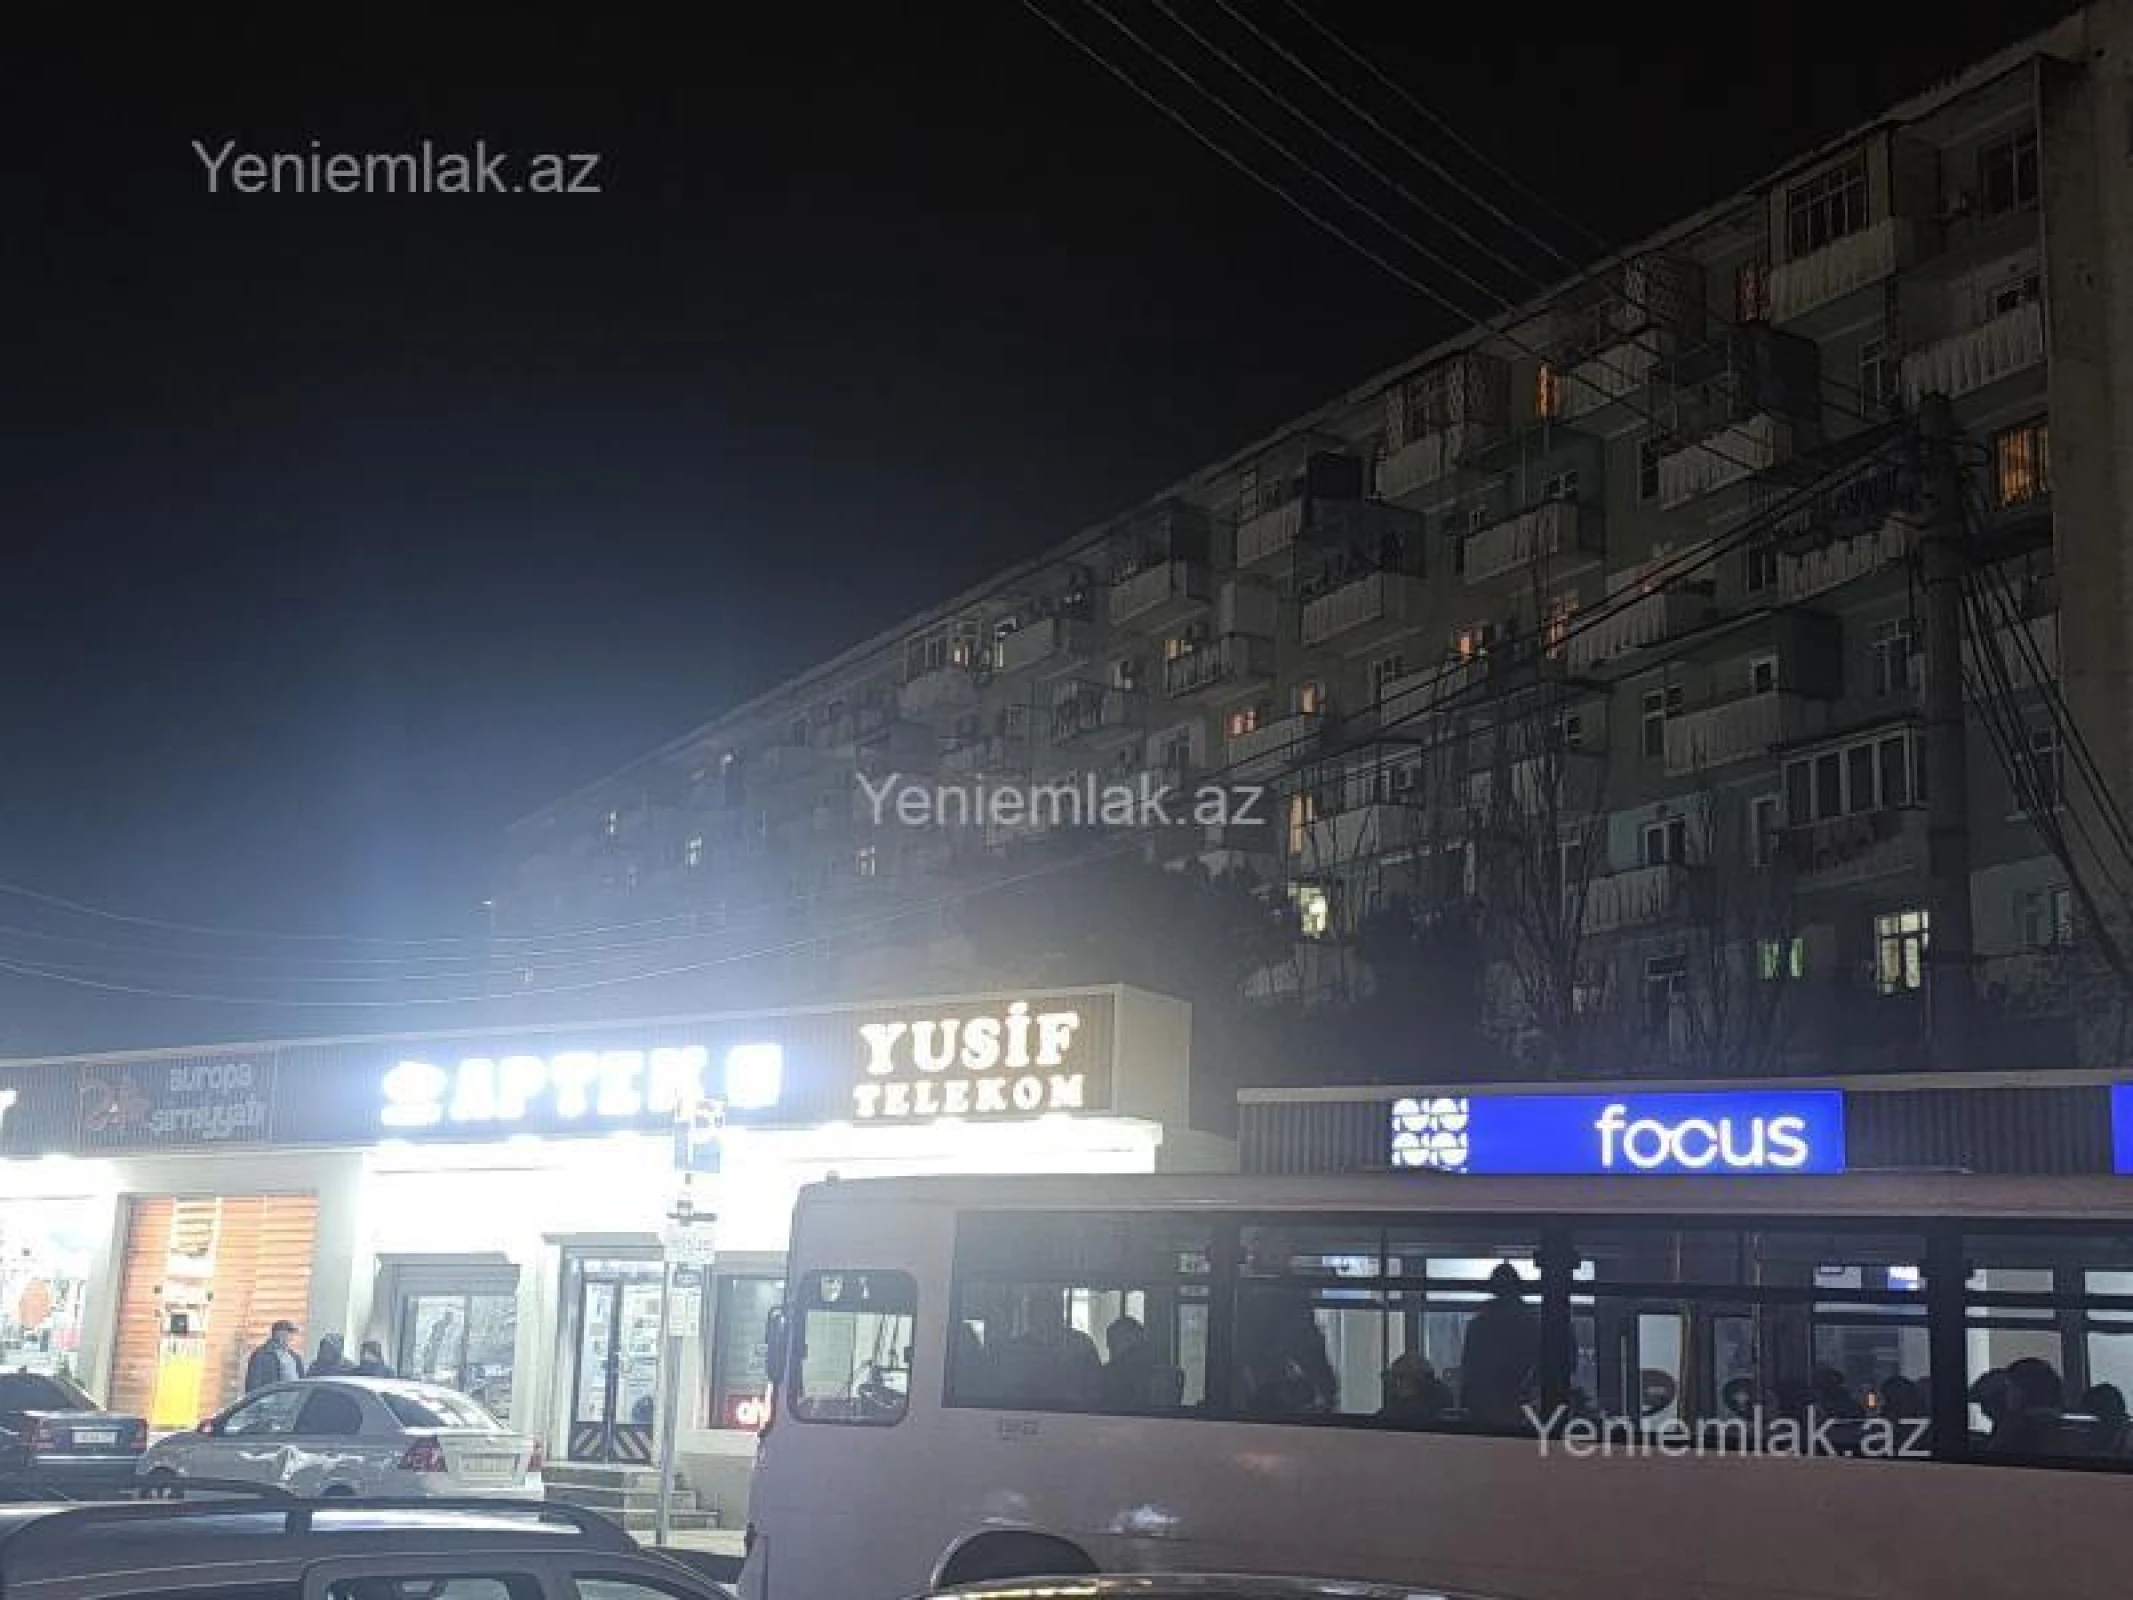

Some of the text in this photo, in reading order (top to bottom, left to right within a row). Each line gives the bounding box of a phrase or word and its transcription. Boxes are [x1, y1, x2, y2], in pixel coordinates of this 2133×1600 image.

[859, 1001, 1081, 1075] YUSİF
[852, 1074, 1084, 1118] TELEKOM
[1594, 1103, 1808, 1168] focus
